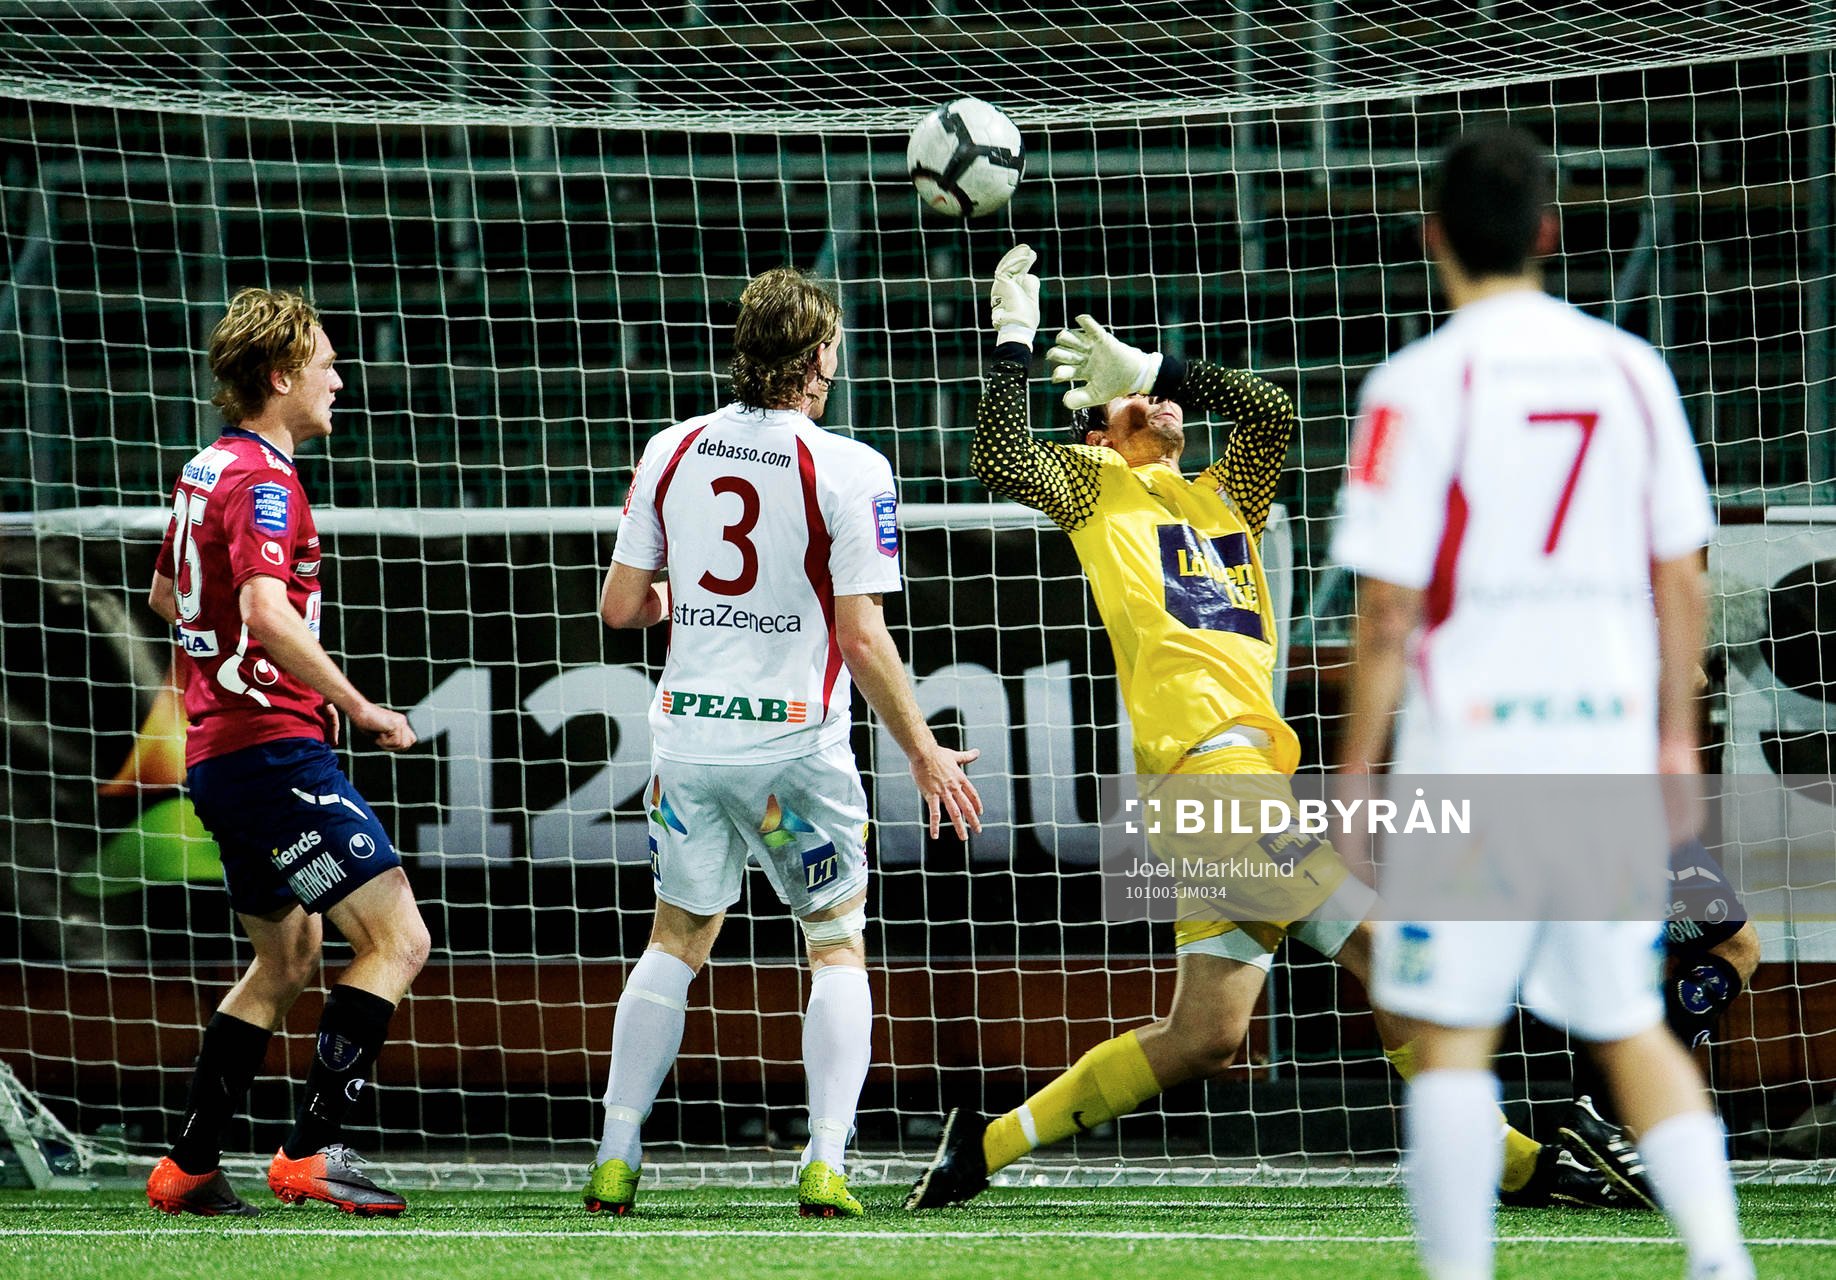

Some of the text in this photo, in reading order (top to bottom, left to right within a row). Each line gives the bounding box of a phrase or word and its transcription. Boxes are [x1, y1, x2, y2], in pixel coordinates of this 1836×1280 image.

[697, 438, 792, 468] debasso.com
[1527, 411, 1599, 556] 7
[698, 476, 760, 596] 3
[671, 603, 801, 634] straZeneca
[670, 691, 788, 723] PEAB
[407, 666, 656, 868] 12
[806, 853, 839, 889] LT
[1303, 869, 1320, 886] 1
